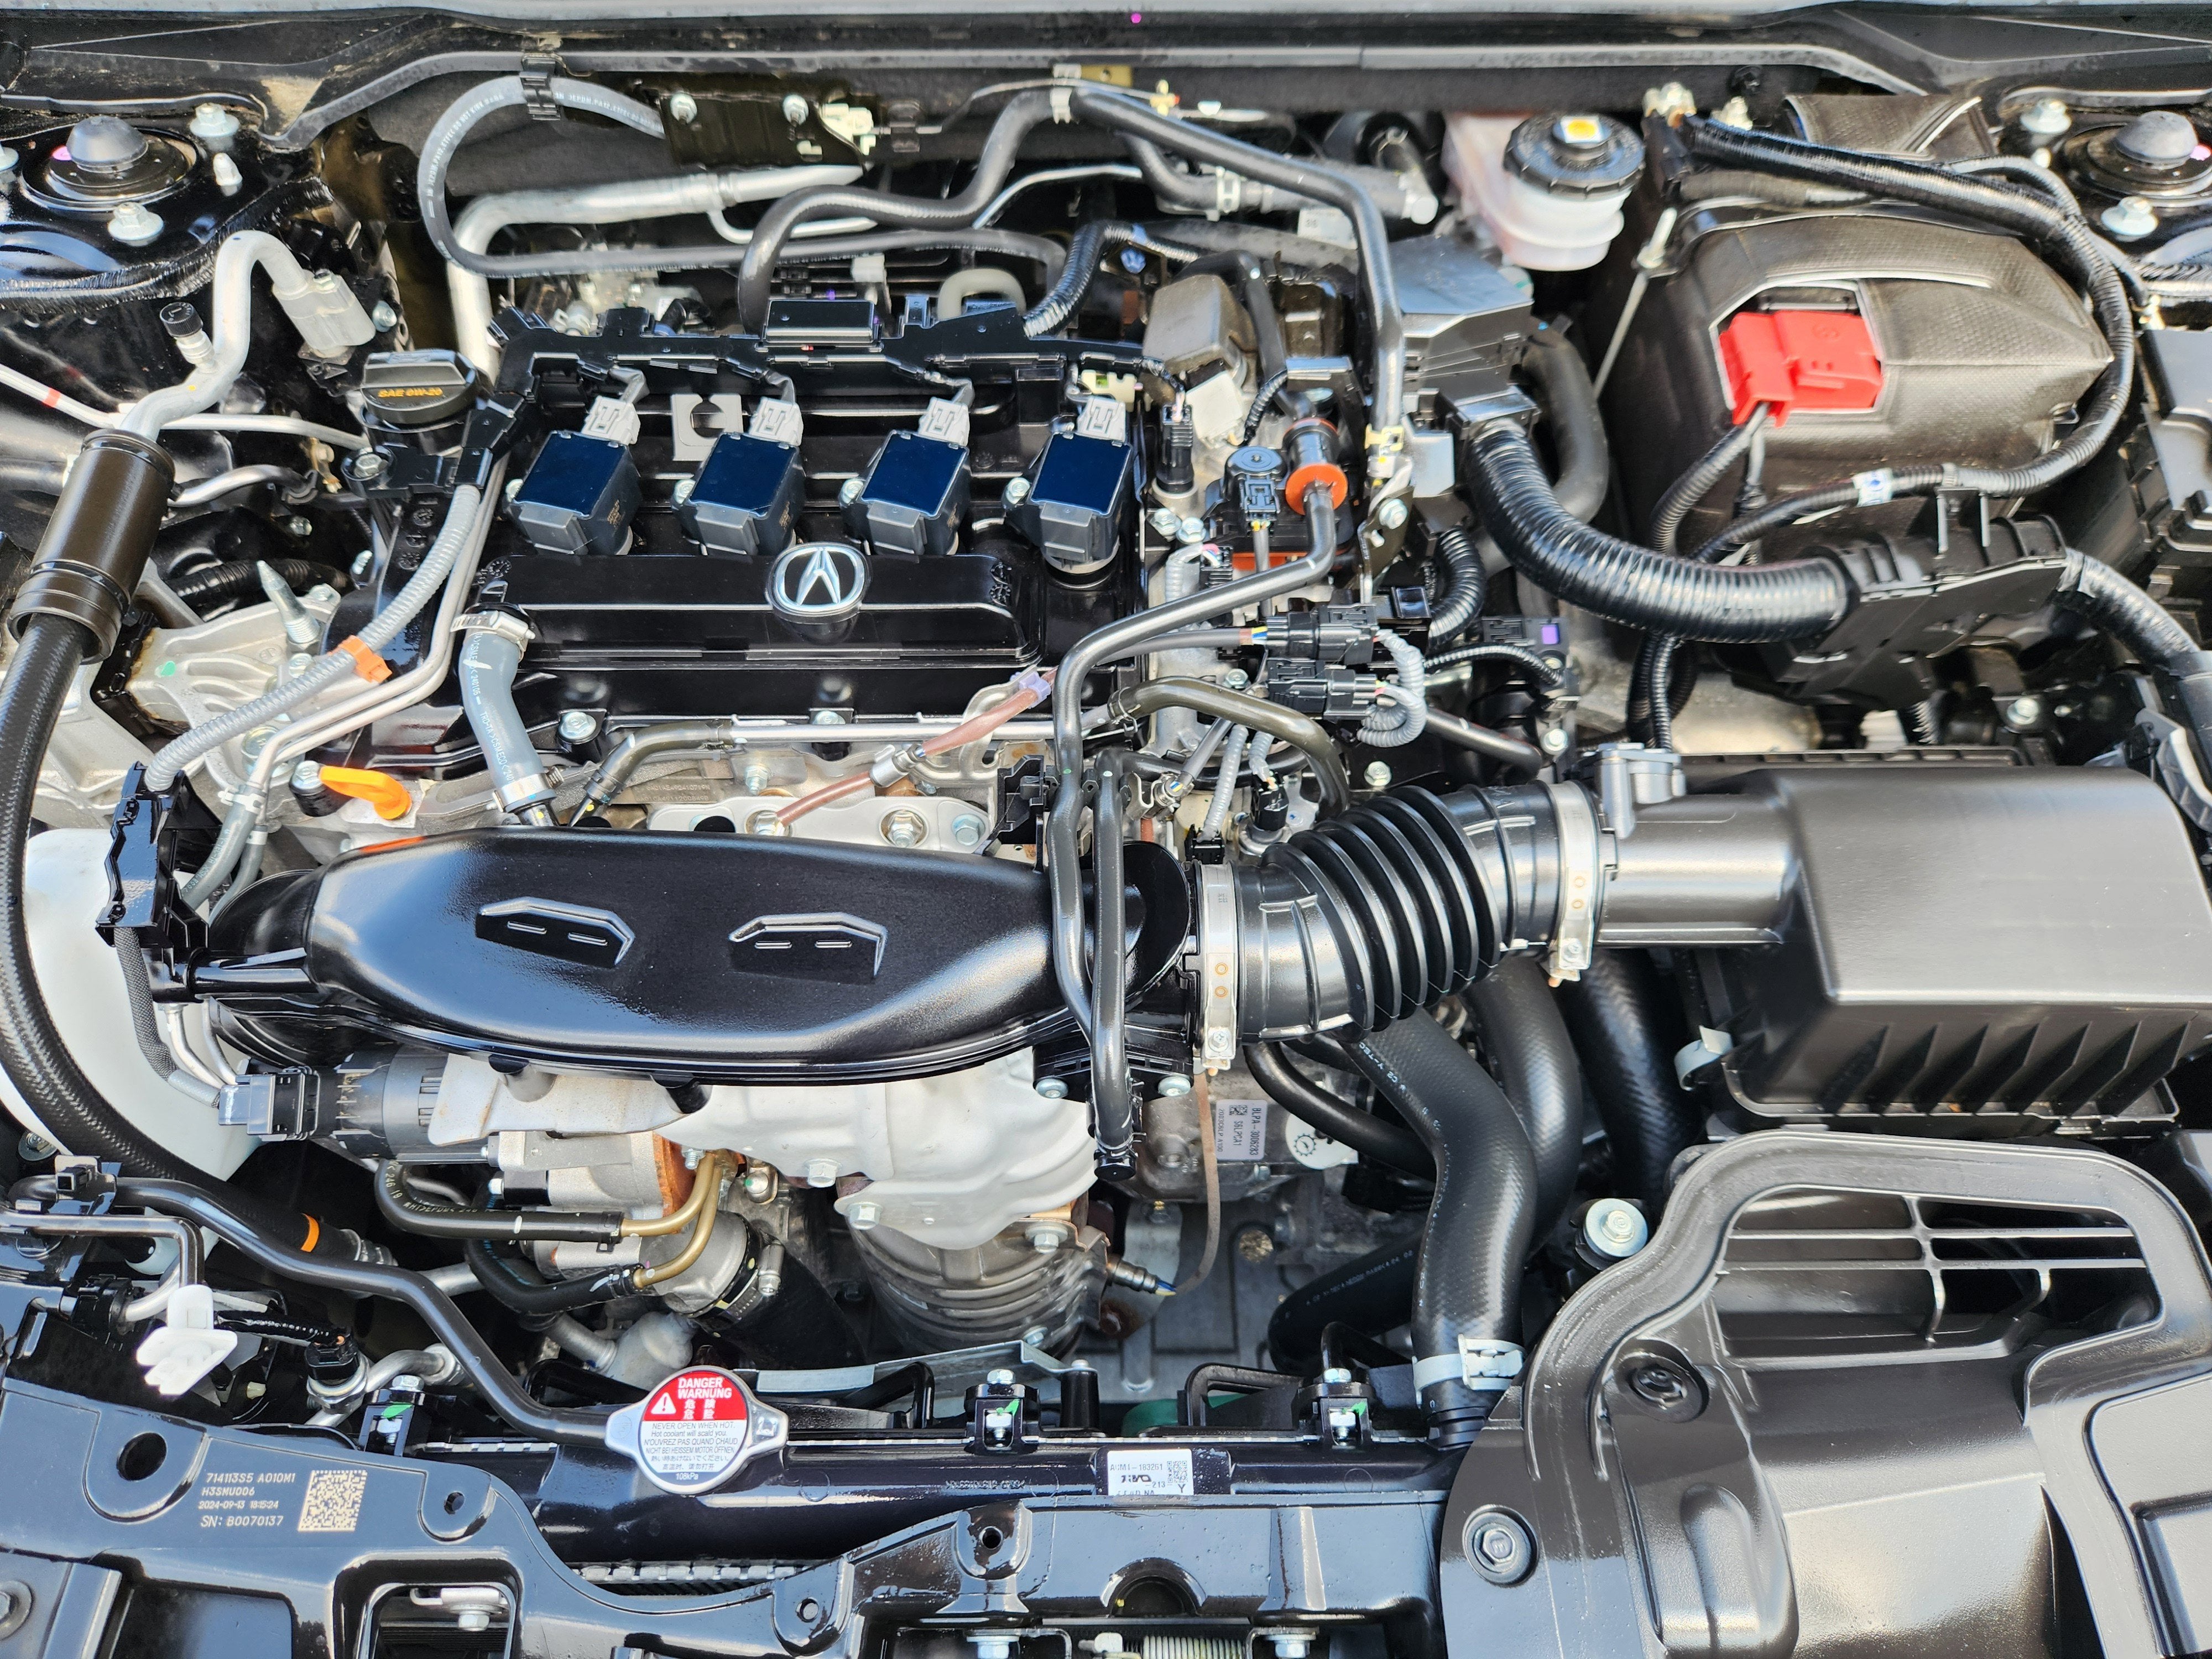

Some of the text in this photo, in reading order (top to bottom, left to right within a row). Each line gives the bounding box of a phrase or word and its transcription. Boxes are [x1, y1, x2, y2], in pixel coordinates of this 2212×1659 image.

[378, 387, 443, 398] SAE 0W-20
[1233, 1120, 1243, 1146] S6LPCA1
[677, 1377, 724, 1389] DANGER
[677, 1387, 733, 1399] WARNUNG
[205, 1472, 296, 1484] 714113S5 A010M1
[201, 1486, 255, 1497] H3SMU006
[197, 1500, 279, 1510] 2024-09-13 18:15:24
[200, 1515, 284, 1528] SN: B0070137
